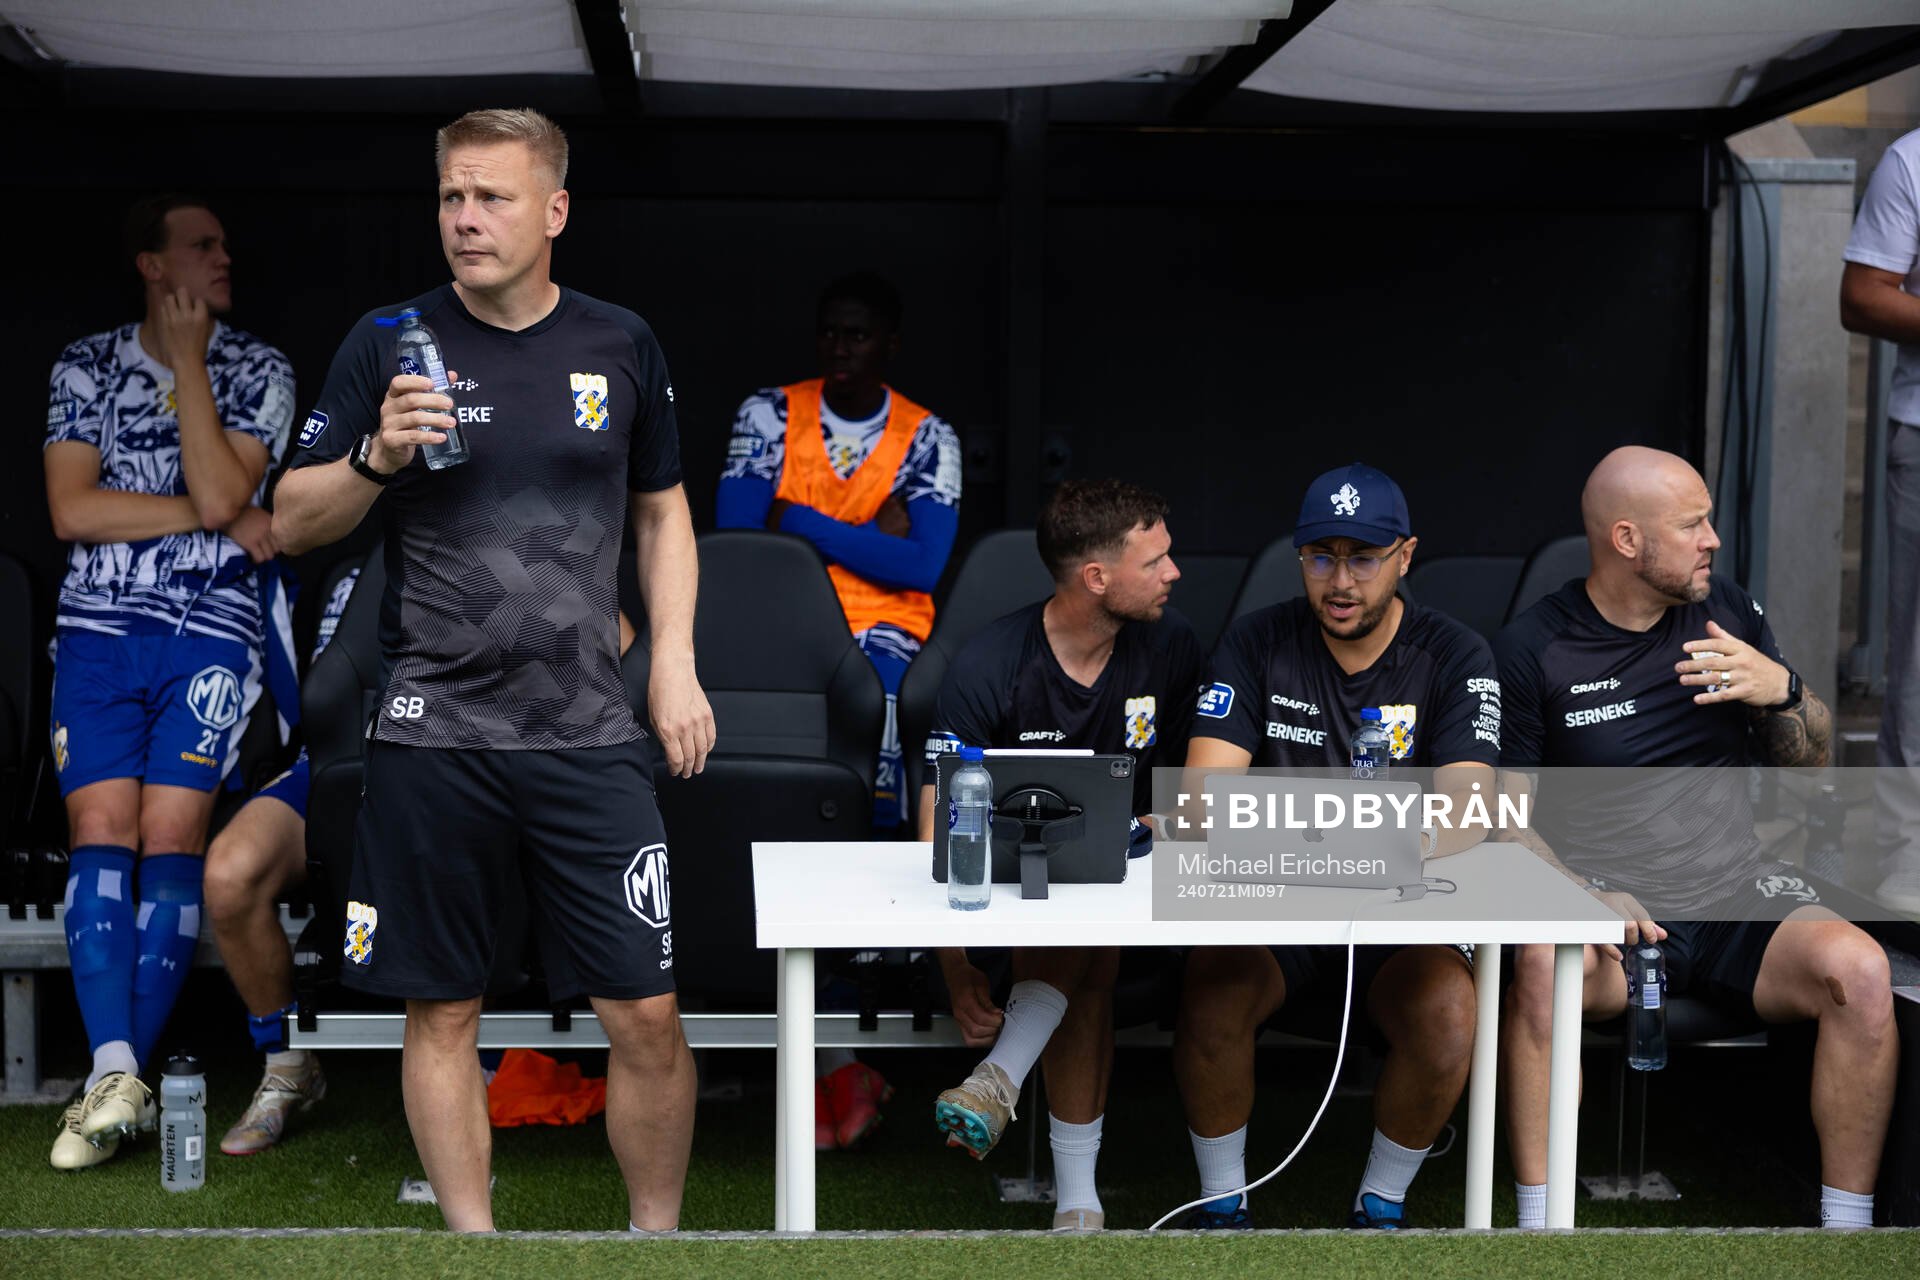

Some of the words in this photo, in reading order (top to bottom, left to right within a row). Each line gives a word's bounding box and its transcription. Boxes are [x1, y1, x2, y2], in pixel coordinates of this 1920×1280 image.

[1570, 680, 1610, 694] CRAFT
[390, 696, 424, 719] SB
[1271, 694, 1311, 712] CRAFT
[1565, 700, 1636, 727] SERNEKE
[1019, 732, 1055, 741] CRAFT
[1266, 720, 1325, 746] ERNEKE
[166, 1123, 176, 1182] MAURTEN
